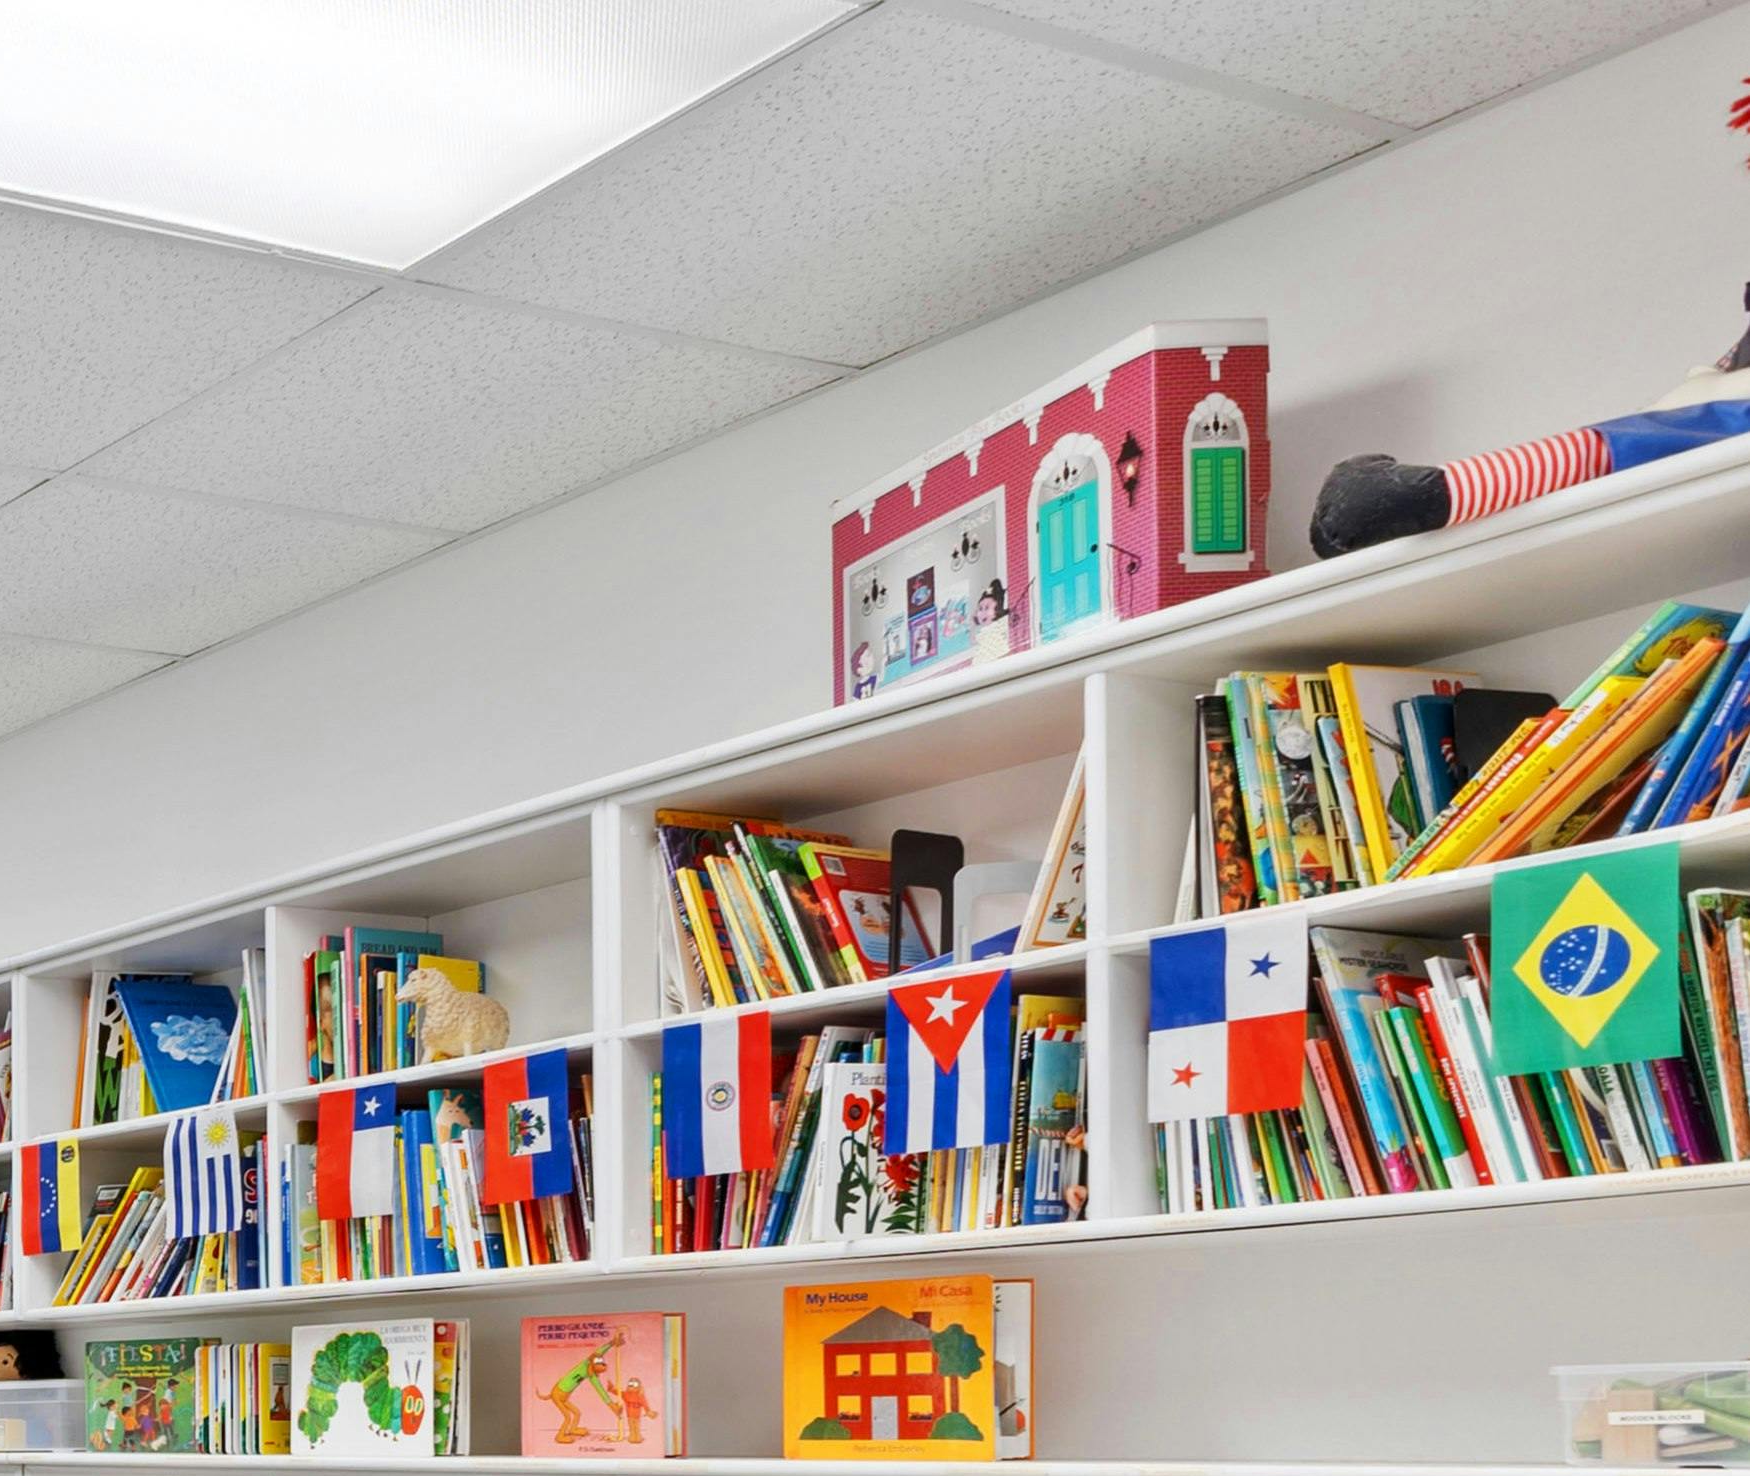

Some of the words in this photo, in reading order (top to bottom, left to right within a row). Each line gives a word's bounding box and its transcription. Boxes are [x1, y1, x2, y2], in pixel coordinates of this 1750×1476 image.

[805, 1293, 826, 1306] My
[828, 1292, 869, 1303] House
[920, 1286, 937, 1299] Mi
[940, 1285, 973, 1297] Casa
